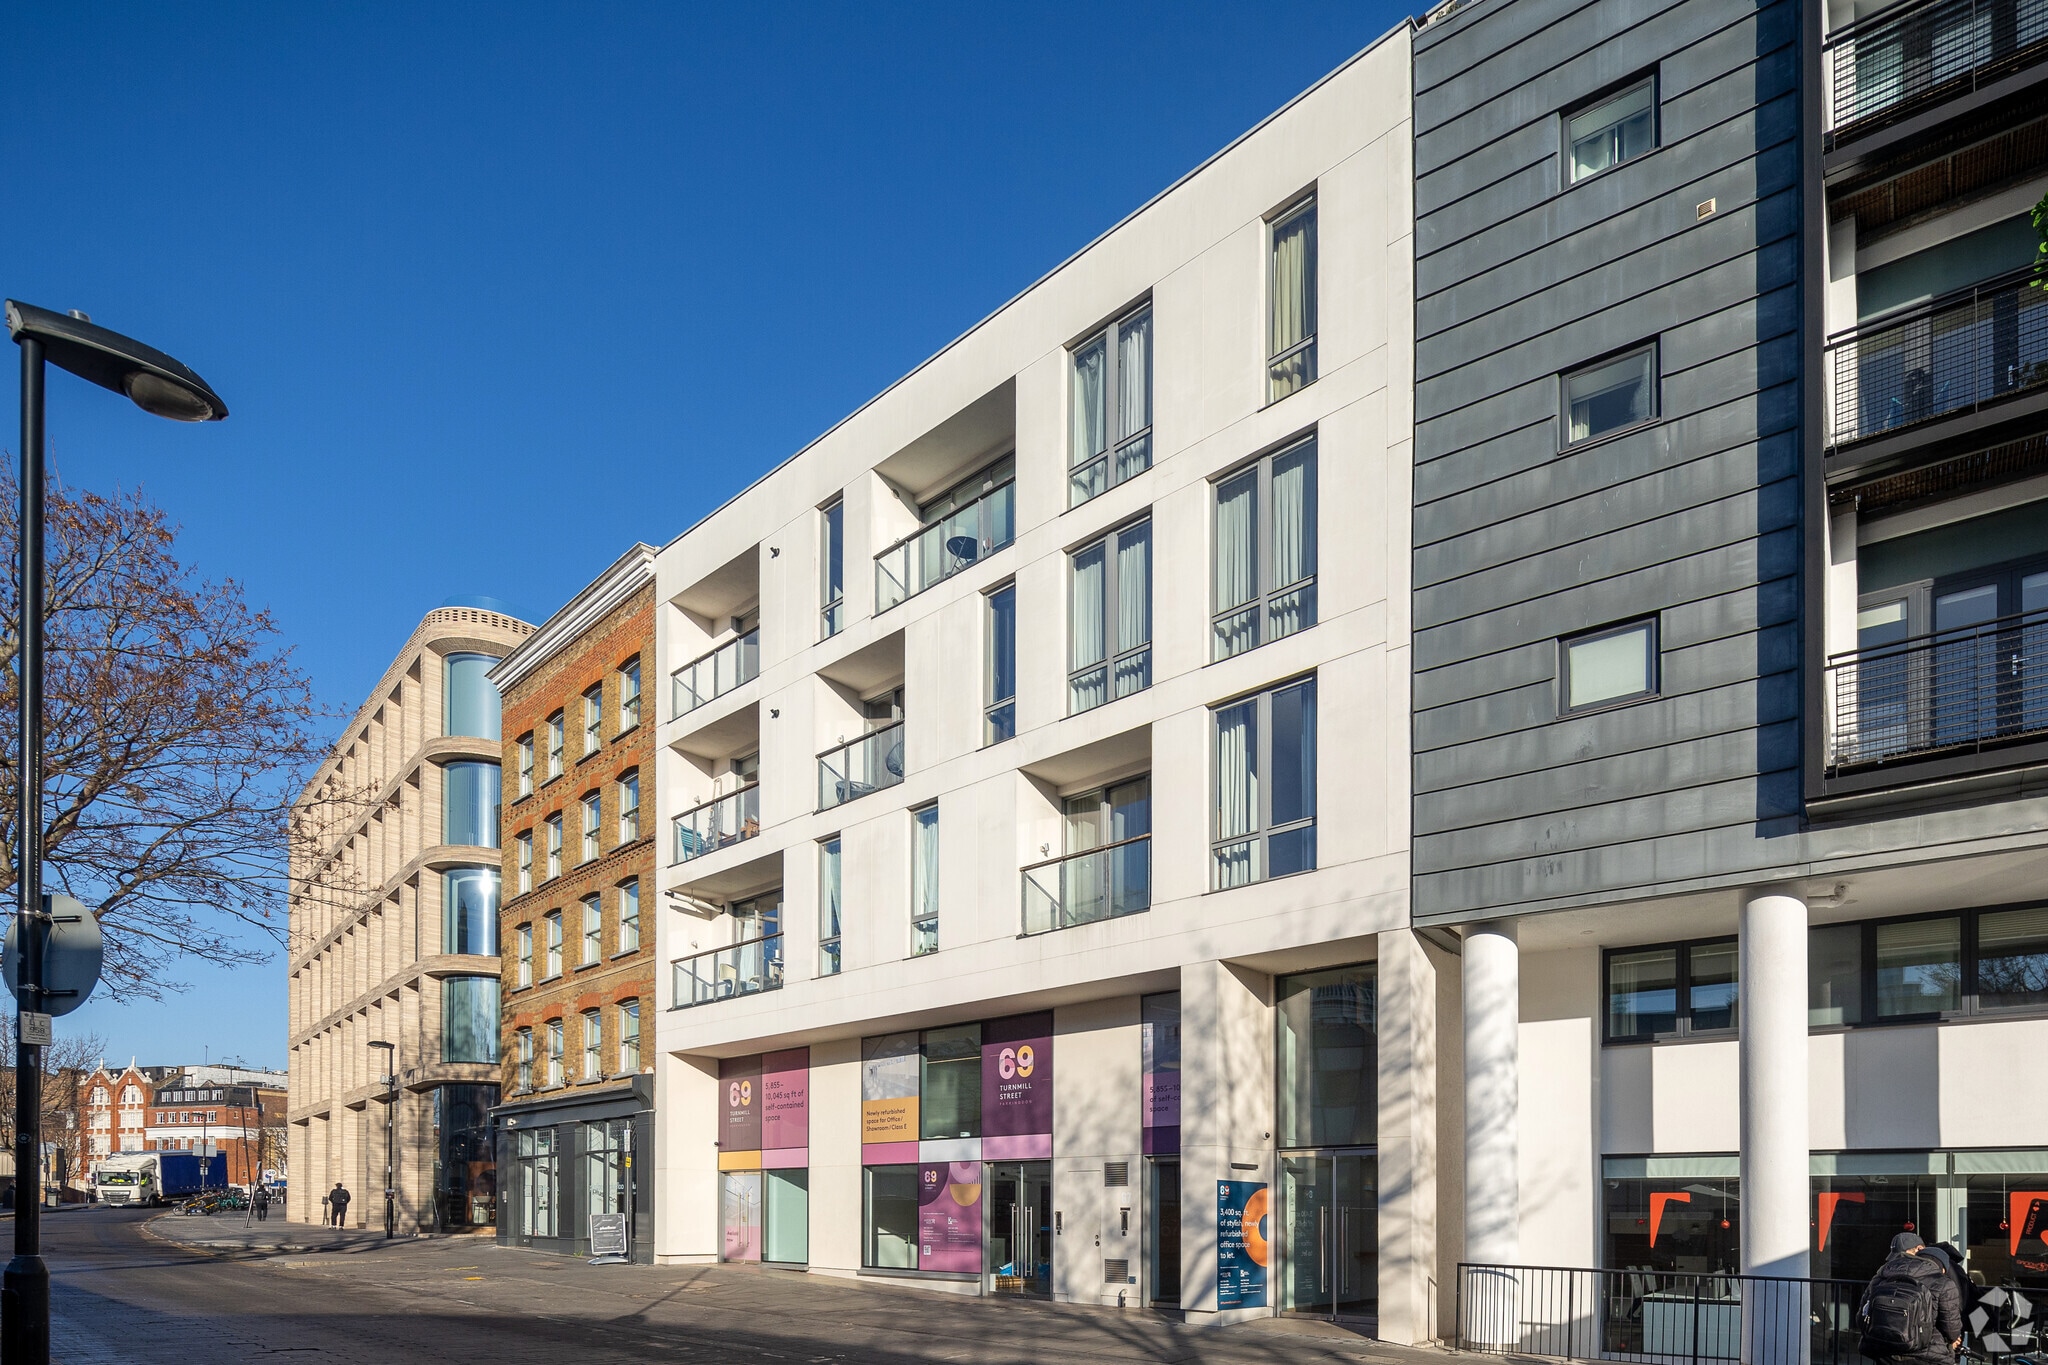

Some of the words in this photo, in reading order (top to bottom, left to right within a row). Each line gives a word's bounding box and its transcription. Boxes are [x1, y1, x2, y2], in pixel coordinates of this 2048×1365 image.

[999, 1045, 1034, 1080] 69
[999, 1083, 1032, 1092] TURNMILL
[730, 1080, 751, 1107] 69
[783, 1092, 790, 1101] sq
[791, 1089, 797, 1098] ft
[797, 1089, 804, 1097] of
[999, 1091, 1022, 1100] STREET
[1149, 1095, 1156, 1103] of
[765, 1100, 804, 1111] self-contained
[765, 1114, 781, 1123] space
[924, 1170, 937, 1183] 69
[1220, 1208, 1234, 1216] 3,400
[2026, 1213, 2037, 1235] PRODUCT
[1220, 1230, 1249, 1238] refurbished
